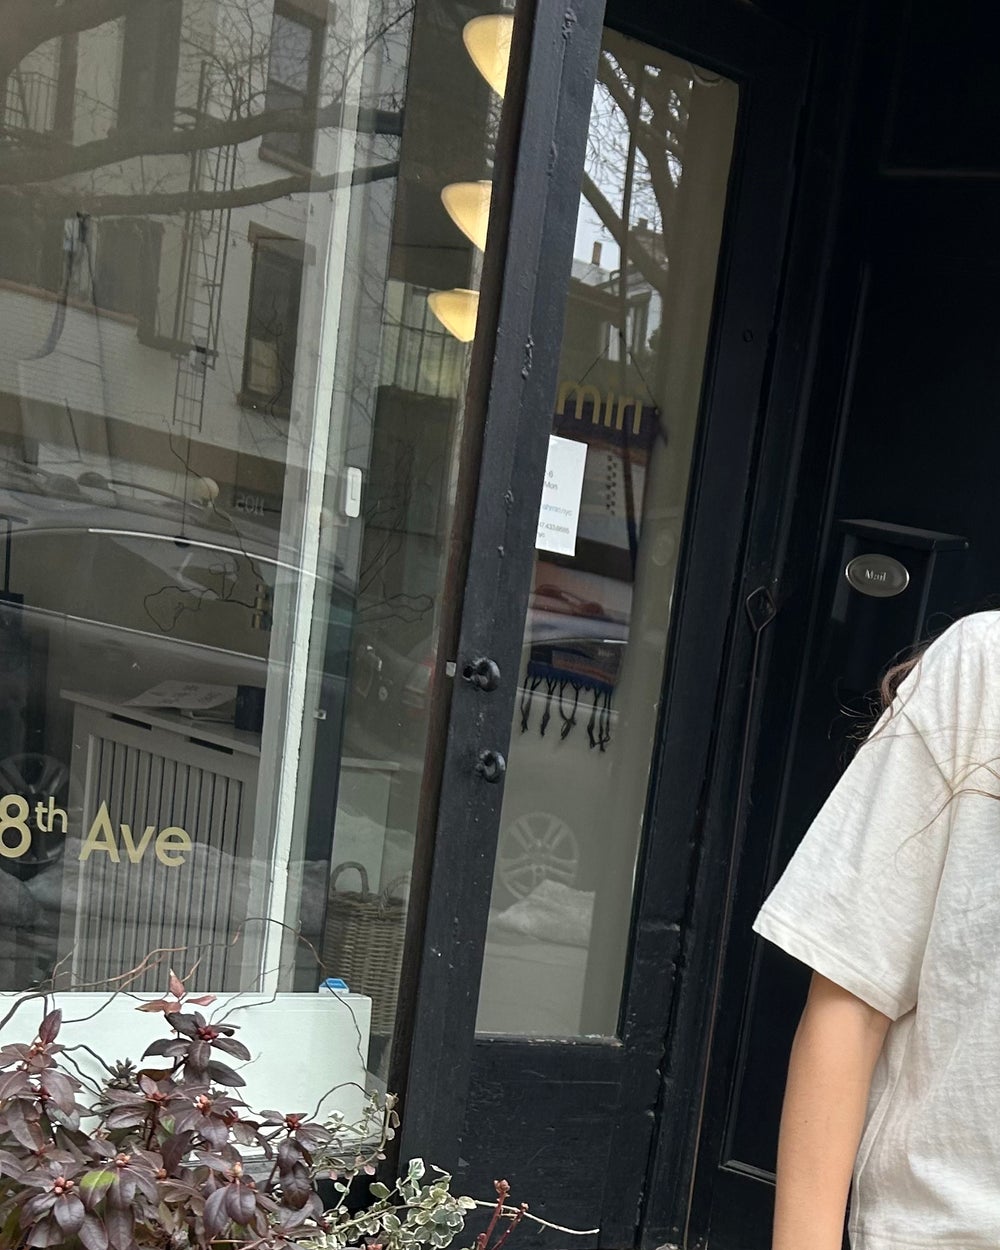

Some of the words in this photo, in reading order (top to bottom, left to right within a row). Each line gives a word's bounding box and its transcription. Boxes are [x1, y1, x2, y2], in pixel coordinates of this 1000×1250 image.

[864, 568, 887, 582] Mail
[0, 793, 68, 859] 8th
[78, 799, 193, 867] Ave
